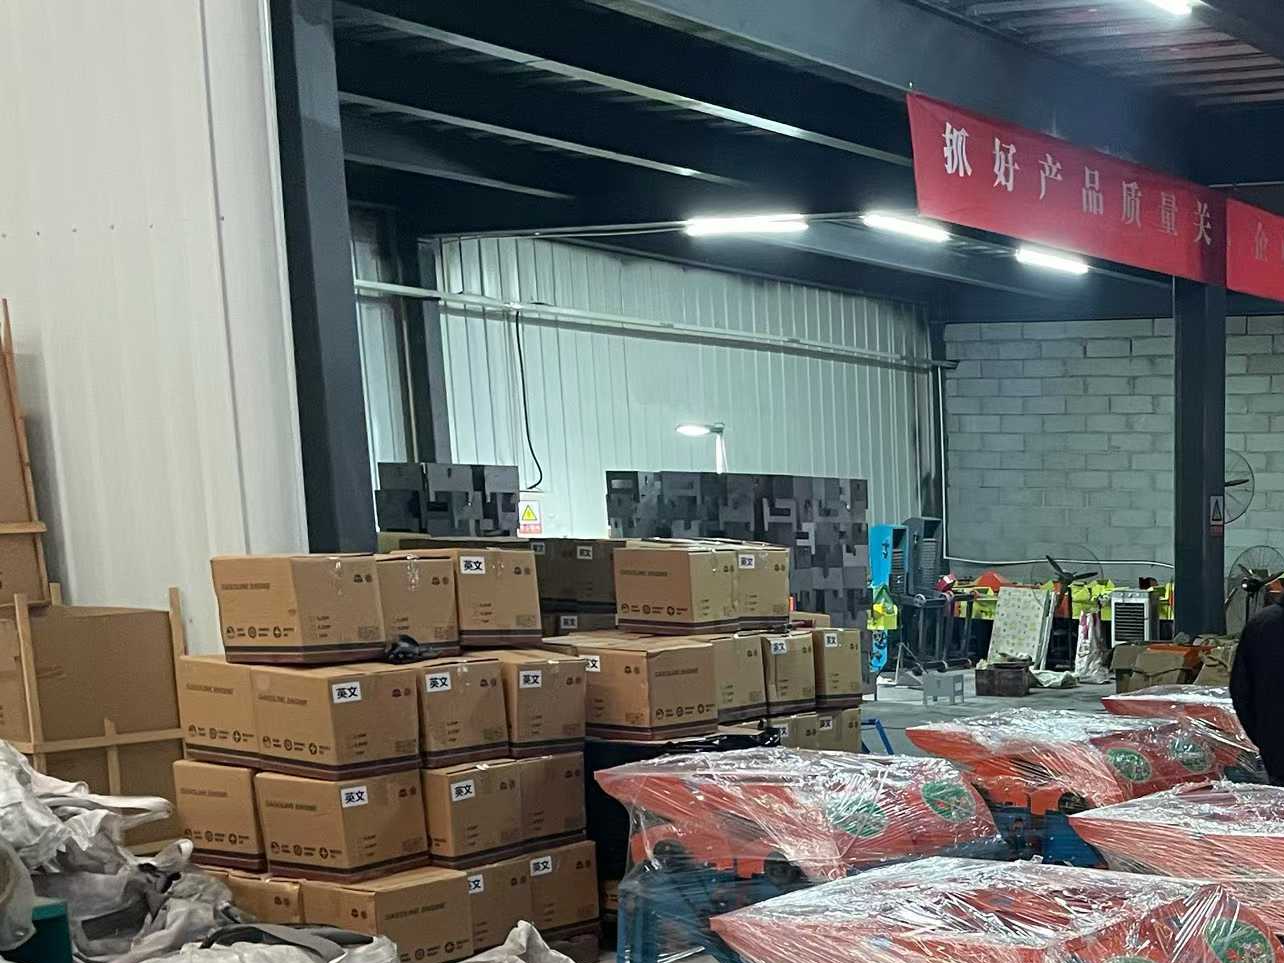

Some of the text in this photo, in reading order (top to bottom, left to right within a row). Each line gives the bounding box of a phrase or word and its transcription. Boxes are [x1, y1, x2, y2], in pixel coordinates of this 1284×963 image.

[941, 121, 1214, 246] 抓好产品质量关
[463, 560, 483, 571] 英文
[429, 677, 448, 688] 英文
[522, 674, 540, 685] 英文
[336, 685, 359, 699] 英文
[344, 790, 366, 803] 英文
[454, 783, 473, 798] 英文
[532, 860, 551, 872] 英文
